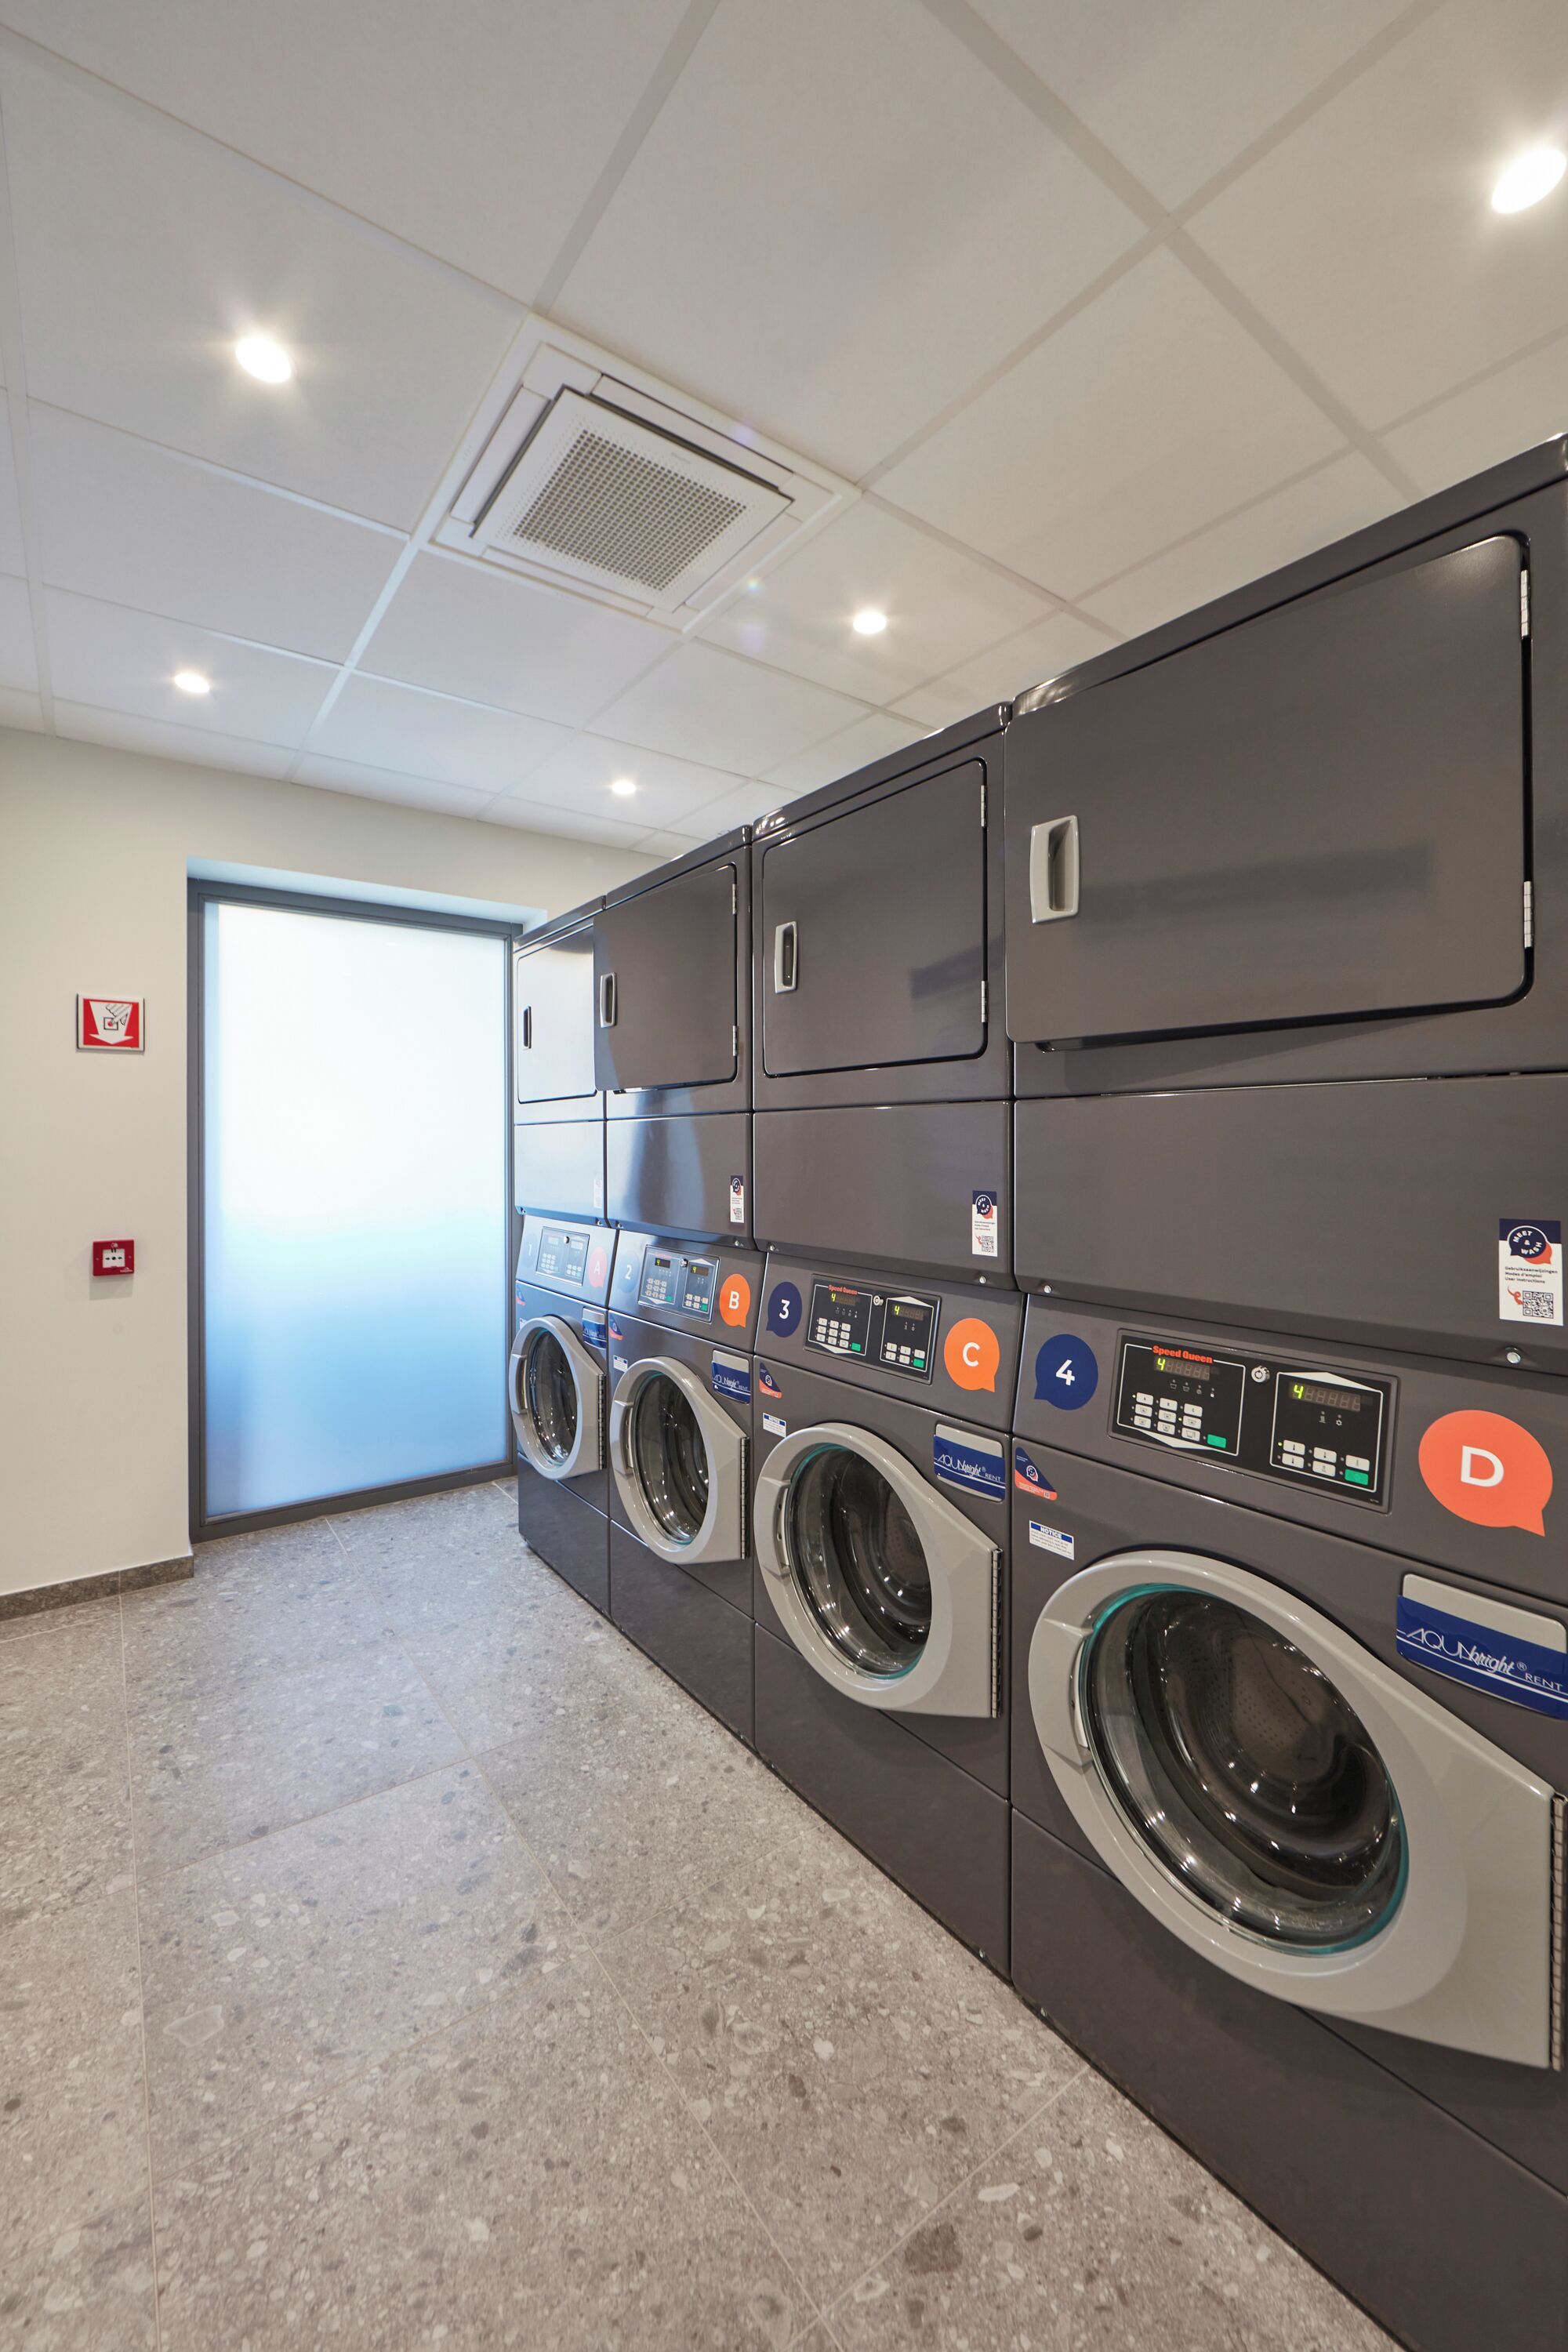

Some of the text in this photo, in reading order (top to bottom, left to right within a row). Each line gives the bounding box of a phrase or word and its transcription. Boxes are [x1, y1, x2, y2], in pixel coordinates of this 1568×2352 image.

[1512, 1230, 1533, 1243] MEET
[528, 1243, 532, 1256] 1
[1521, 1241, 1542, 1254] WASH
[593, 1261, 601, 1276] A
[624, 1264, 632, 1280] 2
[728, 1290, 739, 1310] B
[831, 1293, 836, 1302] 4
[779, 1299, 790, 1319] 3
[894, 1305, 900, 1316] 4
[962, 1341, 980, 1367] C
[1152, 1345, 1213, 1364] Speed Queen
[1157, 1358, 1166, 1370] 4
[1055, 1359, 1076, 1386] 4
[1294, 1385, 1304, 1399] 4
[1461, 1445, 1504, 1487] D
[985, 1473, 1000, 1482] RENT
[1040, 1526, 1062, 1540] NOTICE
[1525, 1672, 1563, 1692] RENT
